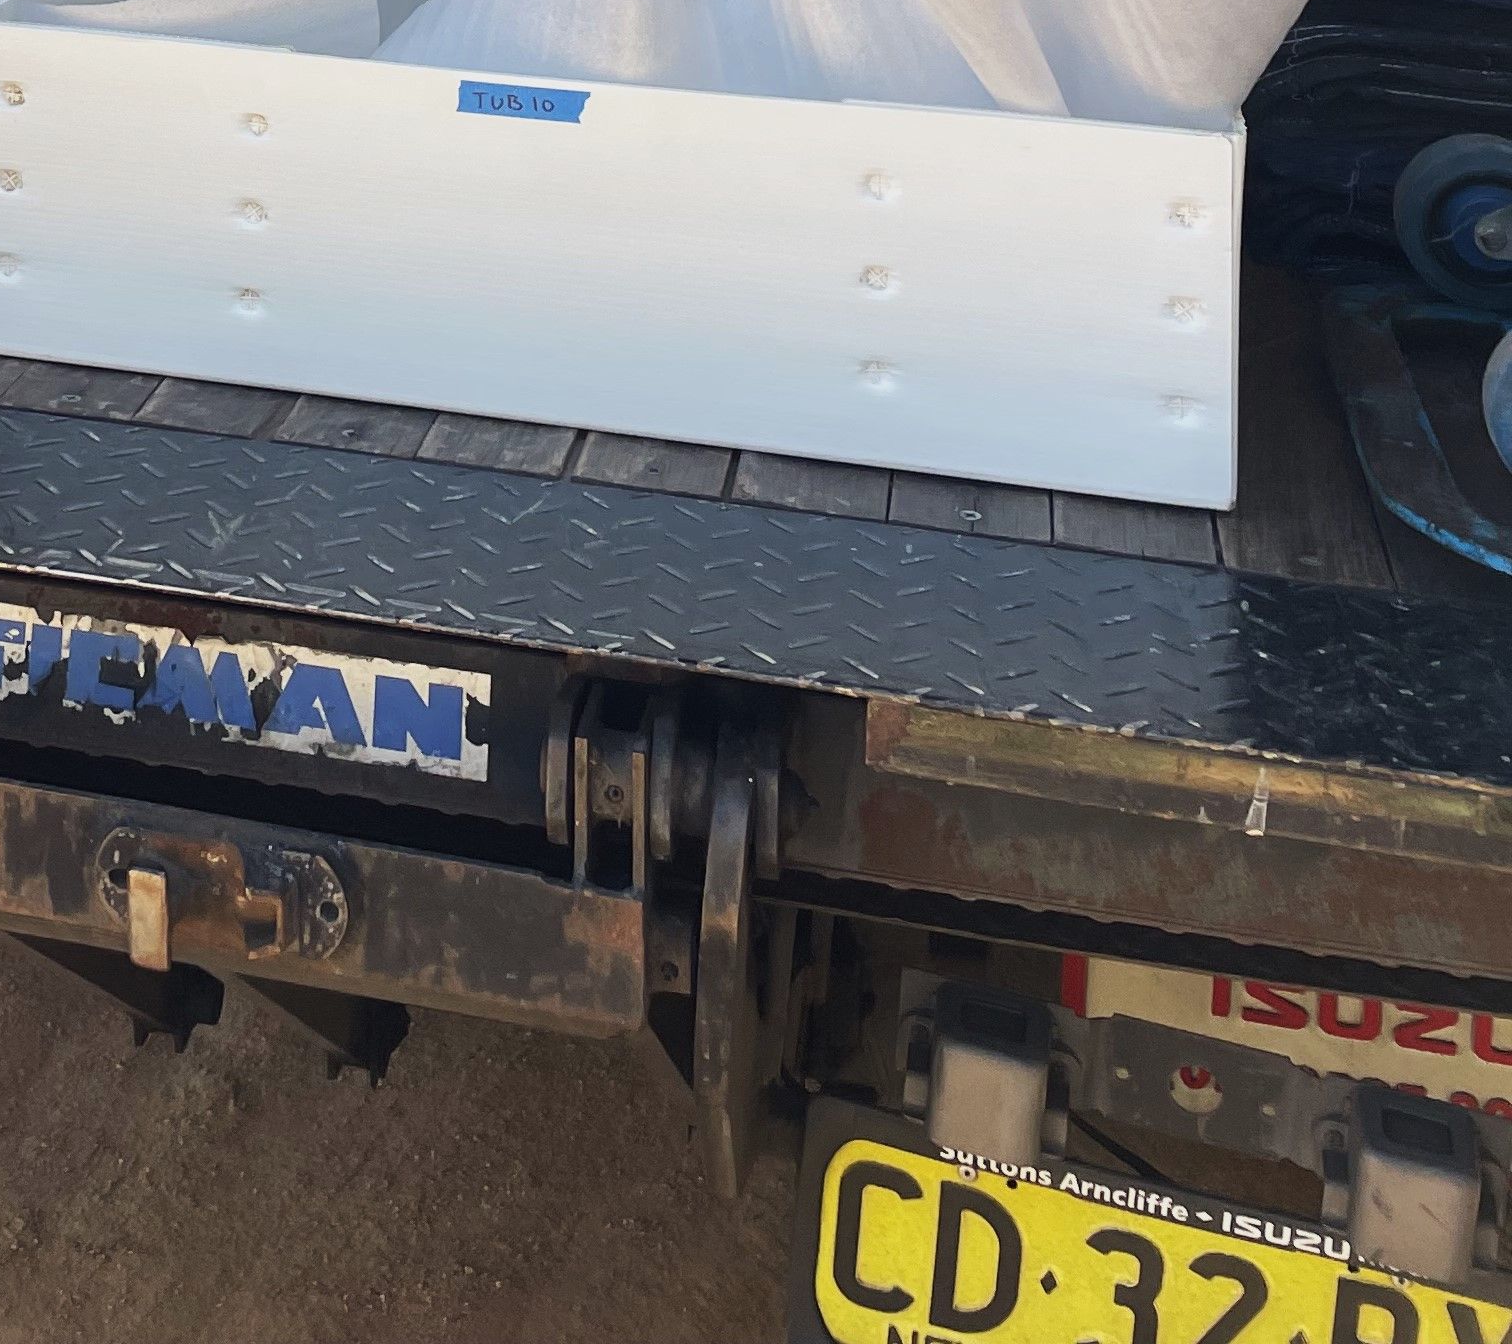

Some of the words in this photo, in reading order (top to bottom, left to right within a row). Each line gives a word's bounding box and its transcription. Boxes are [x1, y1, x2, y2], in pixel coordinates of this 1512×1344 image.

[472, 91, 523, 111] TUB
[532, 96, 555, 113] 10
[939, 1145, 1053, 1186] Suttons
[1059, 1171, 1189, 1222] Arncliffe
[1221, 1211, 1352, 1261] ISUZU
